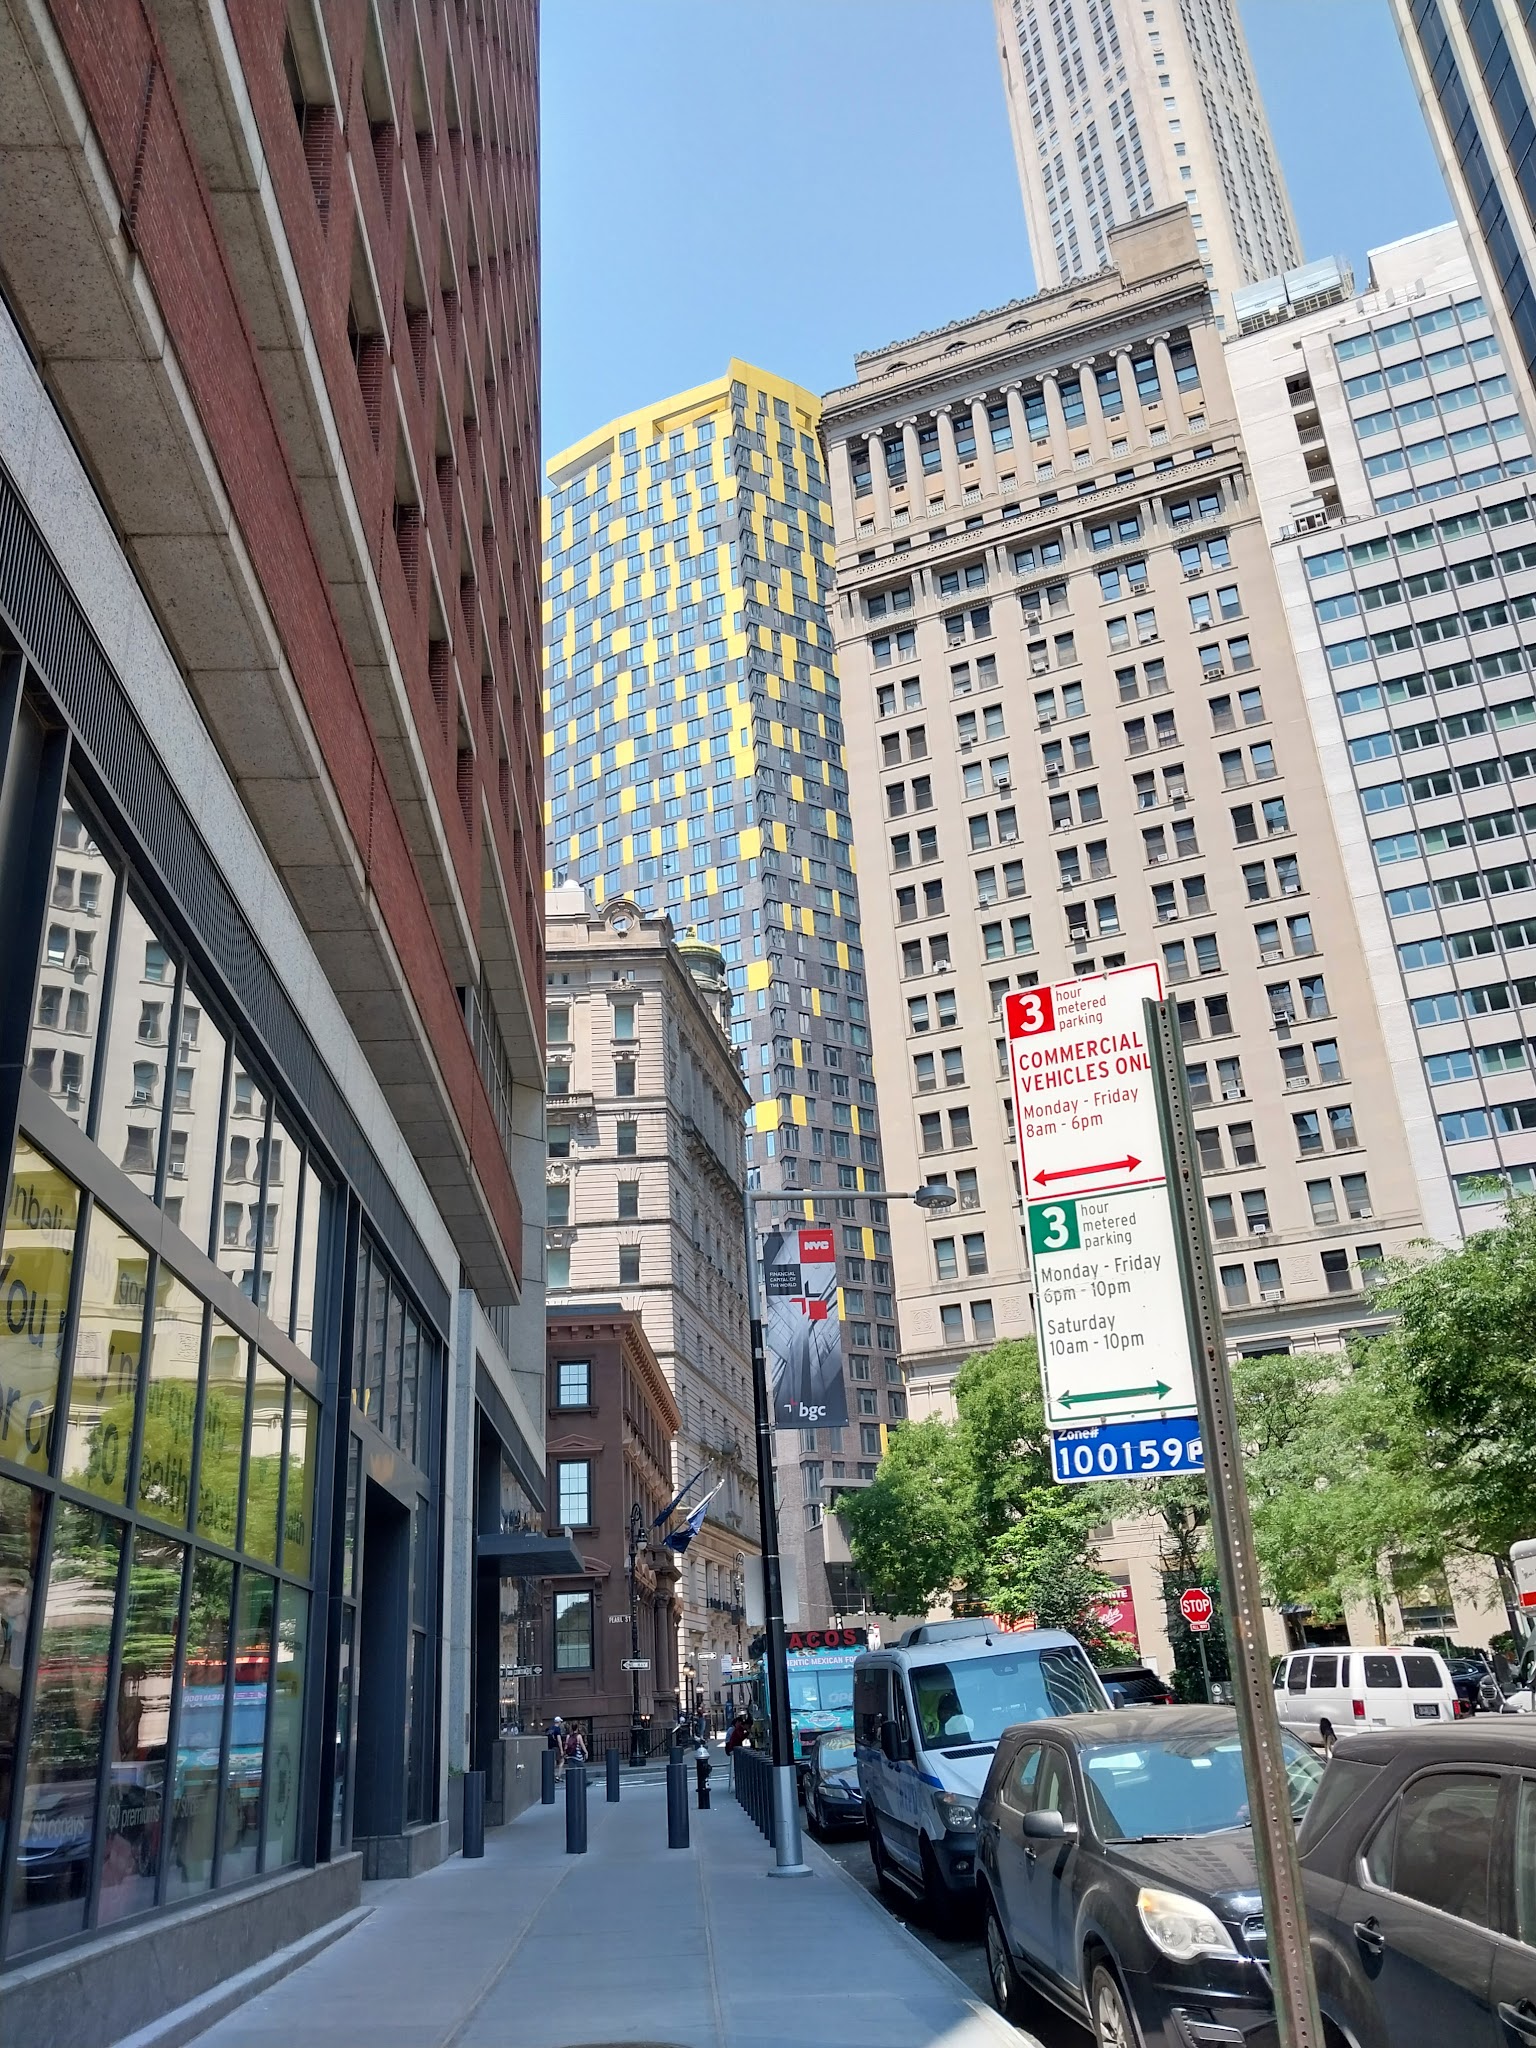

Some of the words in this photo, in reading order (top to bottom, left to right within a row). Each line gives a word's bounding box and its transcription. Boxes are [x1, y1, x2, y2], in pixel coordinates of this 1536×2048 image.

[1055, 988, 1082, 1001] hour
[1019, 994, 1044, 1032] 3
[1057, 995, 1107, 1015] metered
[1059, 1012, 1103, 1032] parking
[1019, 1031, 1143, 1071] COMMERCIAL
[1021, 1061, 1109, 1093] VEHICLES
[1115, 1053, 1151, 1075] ONL
[1024, 1098, 1079, 1120] Monday
[1094, 1088, 1139, 1106] Friday
[1026, 1122, 1057, 1138] 8am
[1071, 1114, 1103, 1133] 6pm
[1081, 1202, 1109, 1217] hour
[1042, 1205, 1069, 1248] 3
[1082, 1212, 1137, 1232] metered
[804, 1241, 829, 1250] NYC
[1084, 1230, 1132, 1250] parking
[1041, 1262, 1099, 1283] Monday
[1114, 1255, 1161, 1273] Friday
[1044, 1287, 1077, 1303] 6pm
[1092, 1280, 1132, 1298] 10pm
[1048, 1314, 1116, 1335] Saturday
[1049, 1338, 1089, 1356] 10am
[1103, 1332, 1145, 1352] 10pm
[799, 1402, 827, 1421] bgc
[1059, 1437, 1183, 1476] 100159
[1183, 1599, 1209, 1613] STOP
[789, 1629, 857, 1649] ACOS
[812, 1656, 843, 1665] MEXICAN
